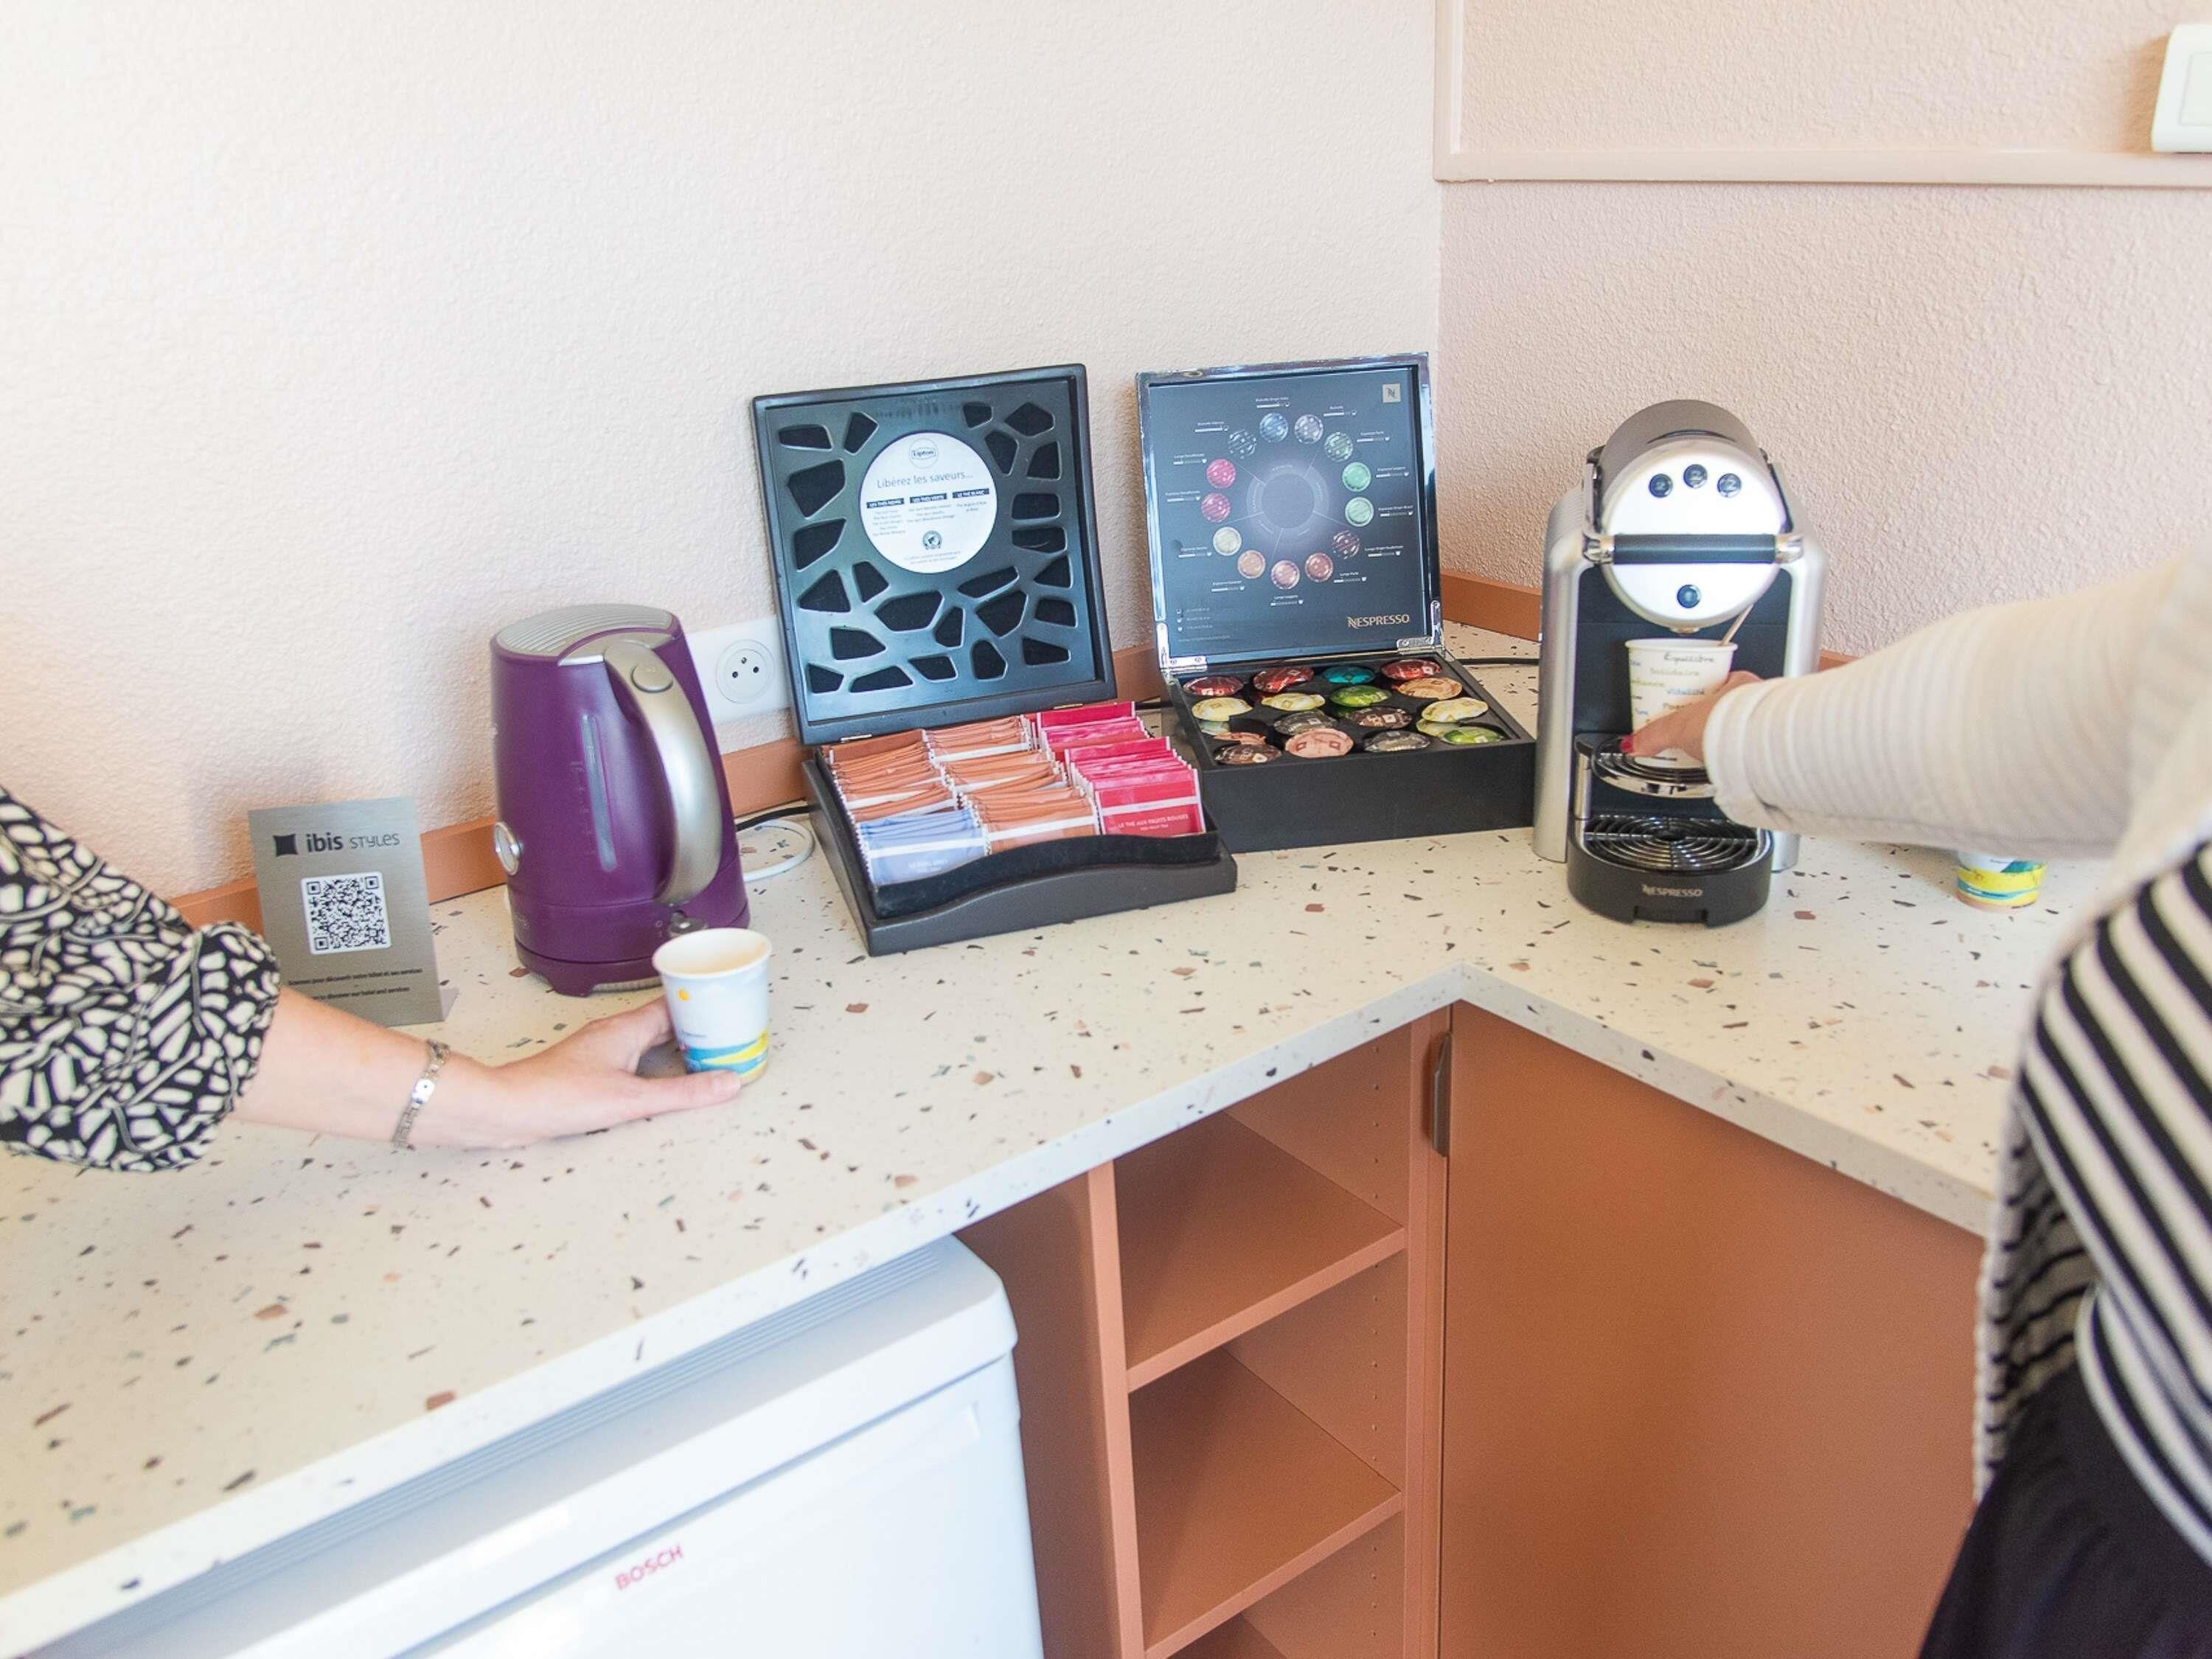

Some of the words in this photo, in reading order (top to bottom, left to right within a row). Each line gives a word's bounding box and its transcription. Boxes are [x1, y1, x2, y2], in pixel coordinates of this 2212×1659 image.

[877, 479, 911, 488] Libérez
[913, 474, 928, 484] les
[1346, 613, 1410, 629] NESPRESSO
[306, 831, 344, 852] ibis
[1641, 884, 1703, 897] NESPRESSO
[613, 1543, 683, 1590] BOSCH
